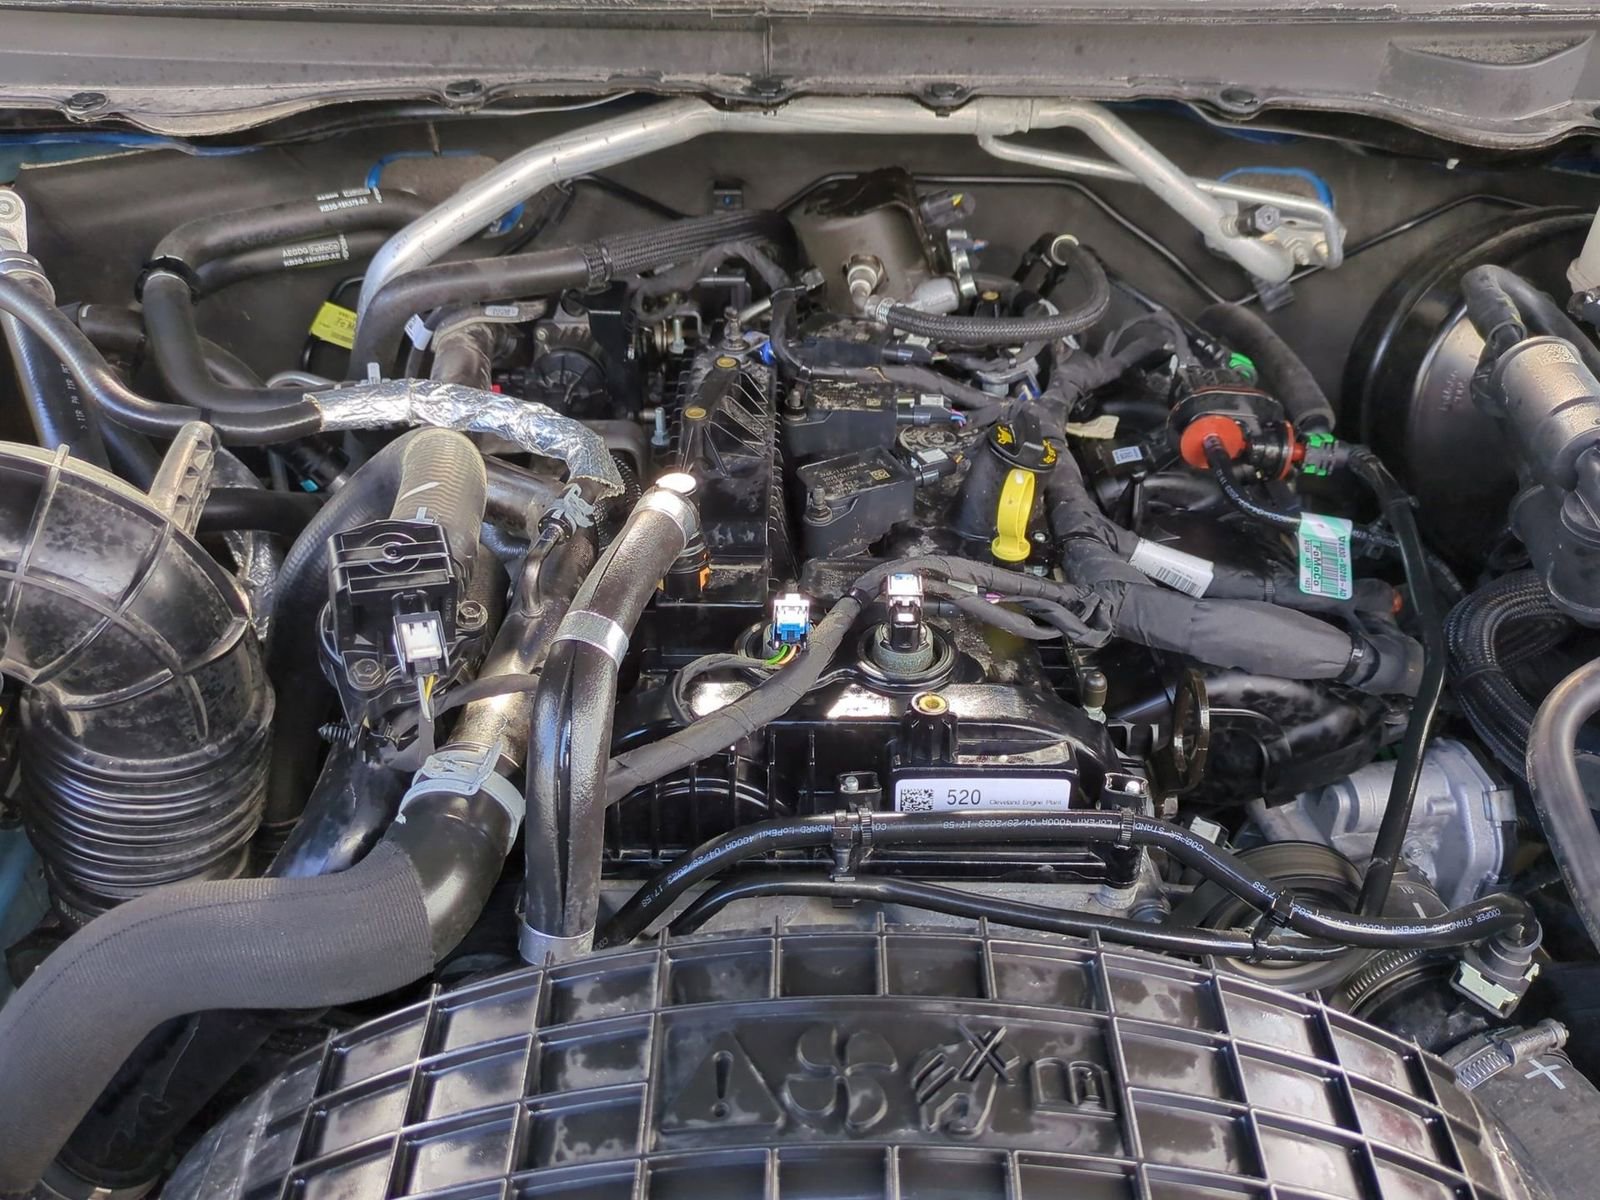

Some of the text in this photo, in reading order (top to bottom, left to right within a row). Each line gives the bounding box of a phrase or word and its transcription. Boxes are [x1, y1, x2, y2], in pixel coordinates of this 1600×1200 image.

[1312, 544, 1321, 587] FoMoCo
[947, 789, 981, 806] 520
[1022, 799, 1044, 807] Engine
[1168, 829, 1204, 852] COOPER
[1476, 908, 1502, 923] COOPER
